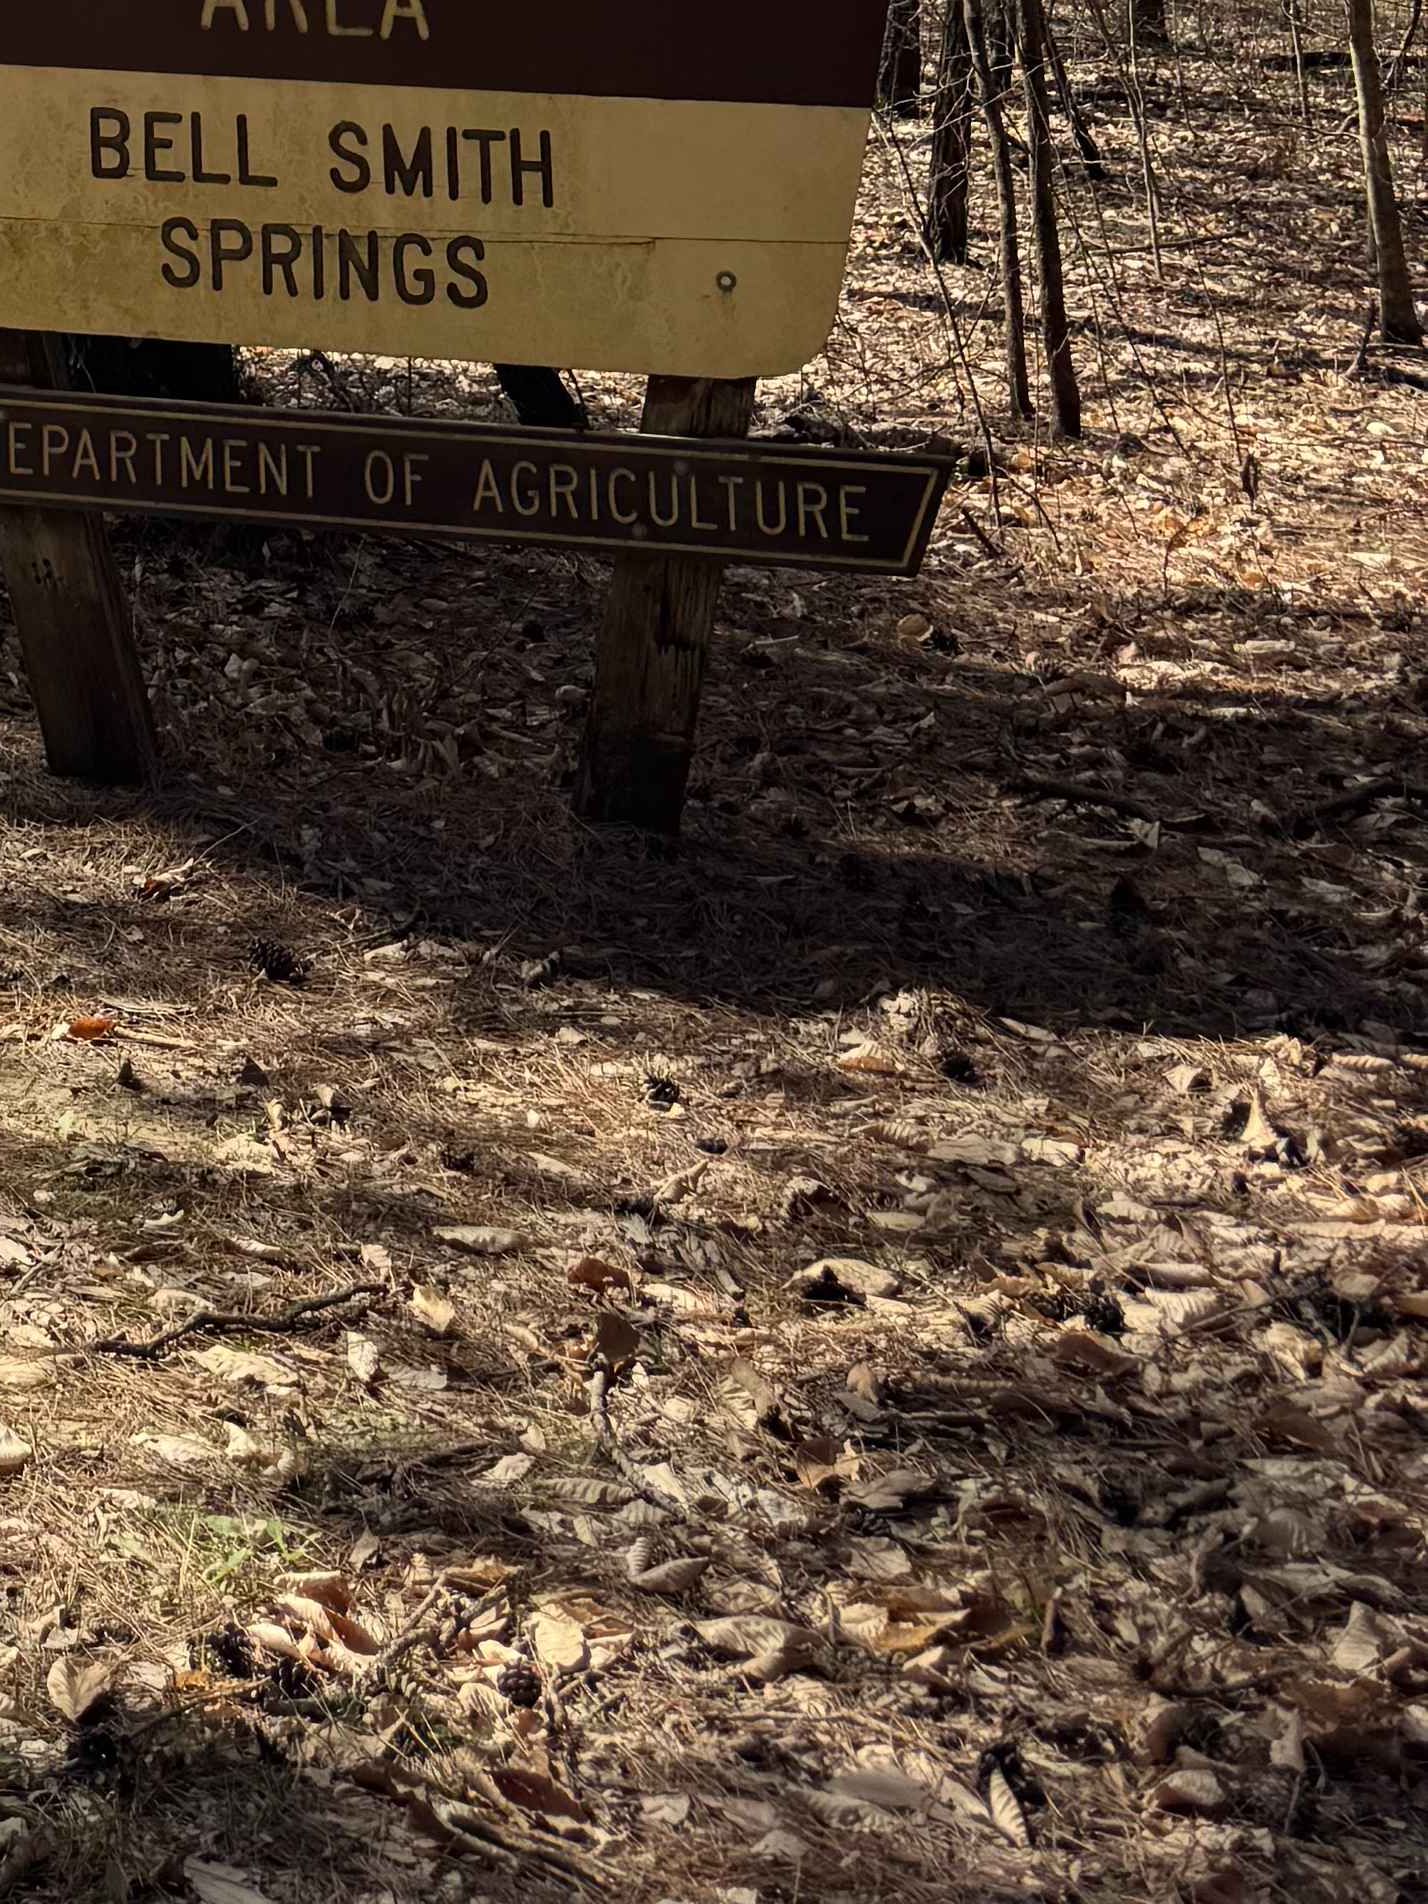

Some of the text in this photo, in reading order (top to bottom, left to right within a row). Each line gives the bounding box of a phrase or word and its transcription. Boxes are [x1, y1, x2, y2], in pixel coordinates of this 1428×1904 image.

[88, 106, 554, 208] BELL SMITH
[160, 217, 490, 309] SPRINGS
[364, 452, 428, 507] OF
[474, 460, 872, 543] AGRICULTURE
